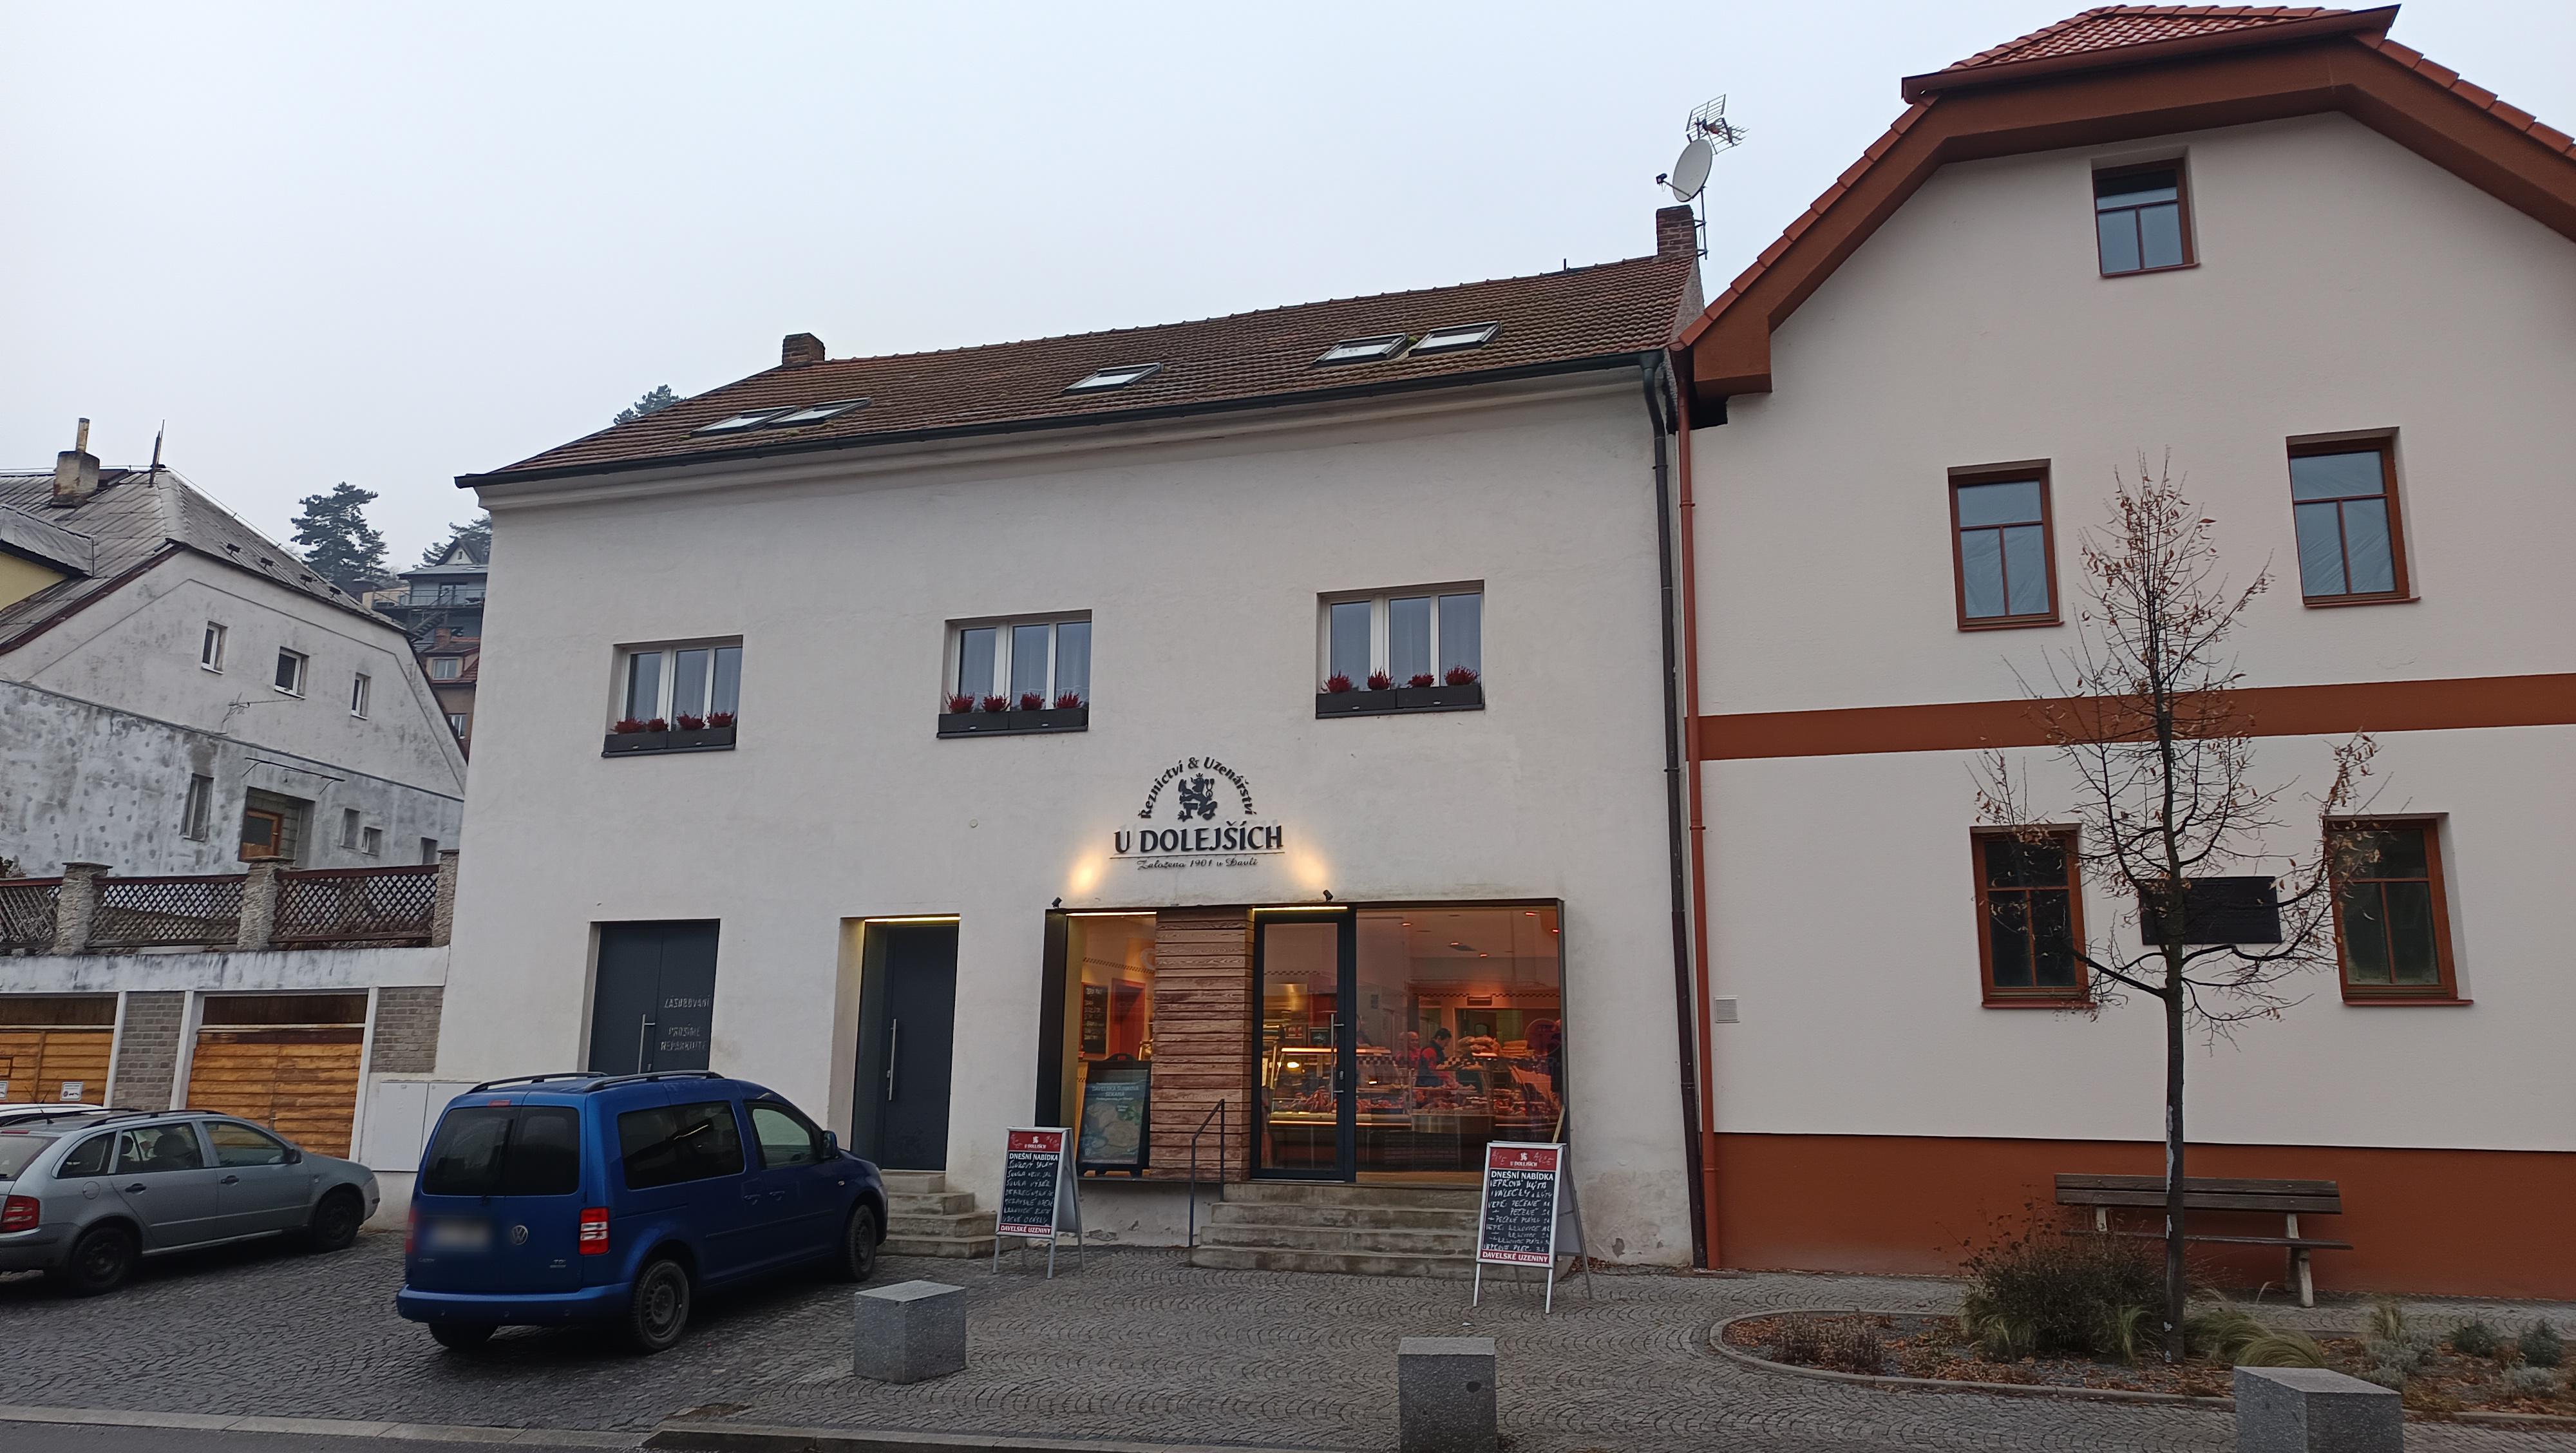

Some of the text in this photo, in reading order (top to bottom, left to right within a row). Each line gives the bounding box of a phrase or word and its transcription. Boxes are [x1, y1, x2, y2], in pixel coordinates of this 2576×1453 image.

[1137, 757, 1257, 819] Řeznictví & Uzenářství
[1114, 821, 1283, 853] U DOLEJŠÍCH
[1190, 859, 1212, 868] 1901
[1226, 857, 1258, 867] Davli
[1491, 1170, 1553, 1181] DNEŠNÍ NABÍDKA
[1482, 1251, 1548, 1262] DAVELSKÉ UZENINY
